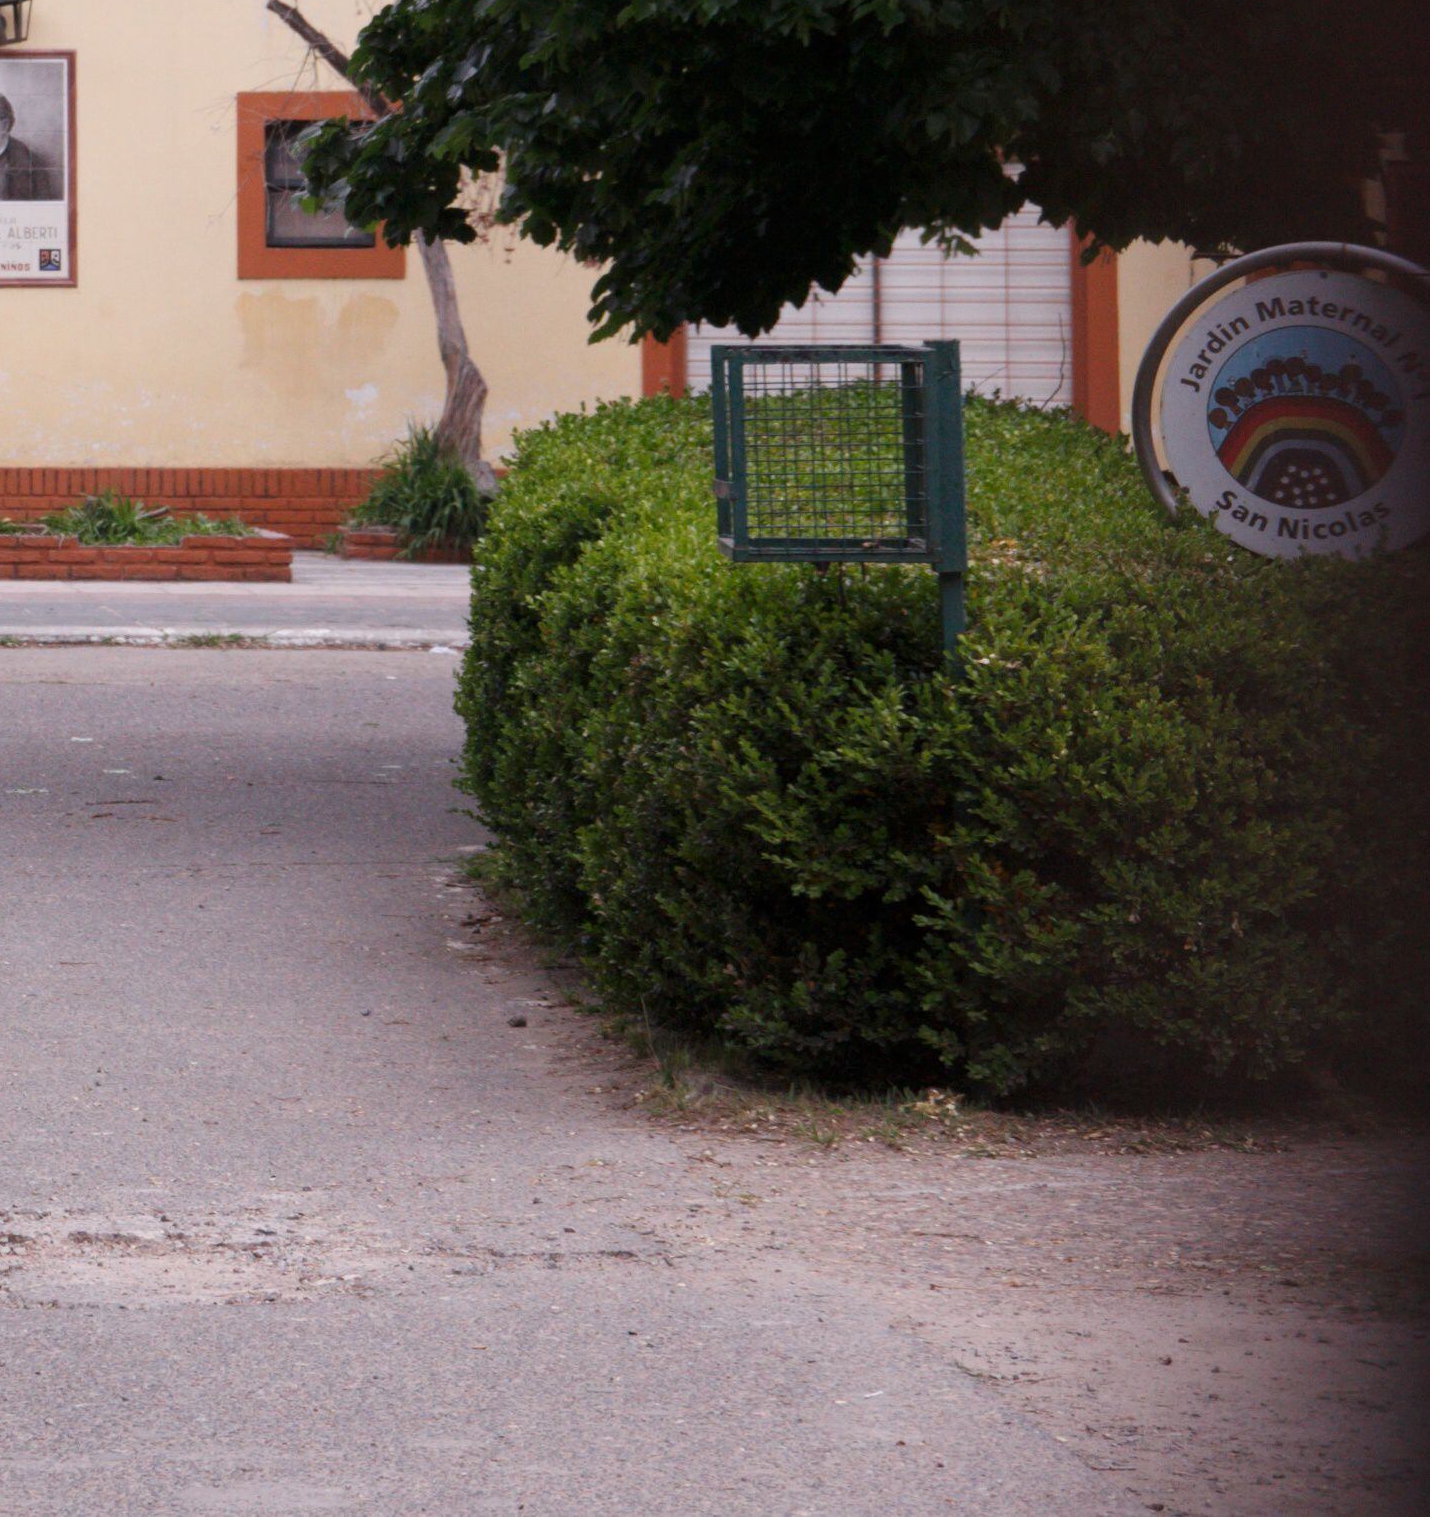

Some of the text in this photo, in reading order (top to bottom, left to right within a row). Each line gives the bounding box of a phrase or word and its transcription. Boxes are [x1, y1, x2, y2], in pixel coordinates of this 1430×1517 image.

[7, 226, 58, 239] ALBERTI
[1180, 314, 1250, 393] Jardin
[1255, 295, 1401, 348] Maternal
[1216, 490, 1390, 540] San Nicolas
